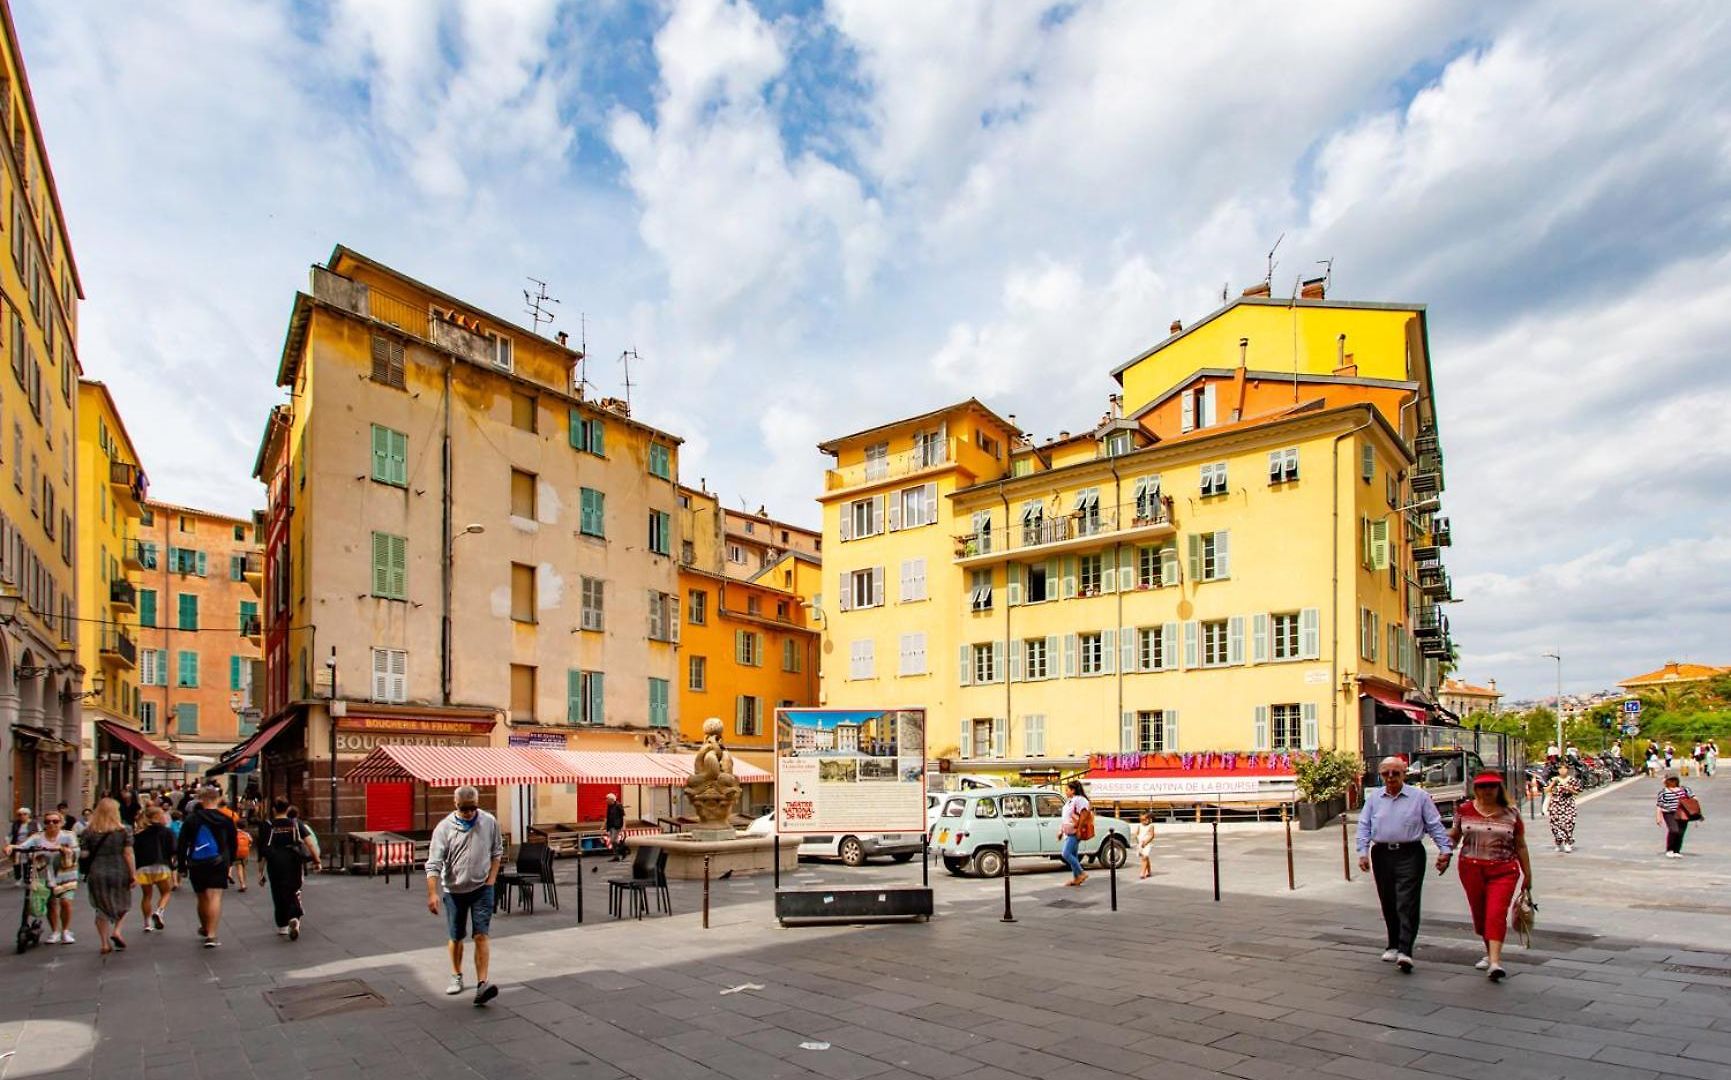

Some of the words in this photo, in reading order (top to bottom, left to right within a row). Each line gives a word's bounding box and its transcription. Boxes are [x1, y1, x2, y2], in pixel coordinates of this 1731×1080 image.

[365, 719, 417, 730] BOUCHERIE
[1143, 781, 1183, 792] CANTINA
[1185, 781, 1199, 791] DE
[1201, 781, 1213, 791] LA
[1215, 780, 1258, 791] BOURSE
